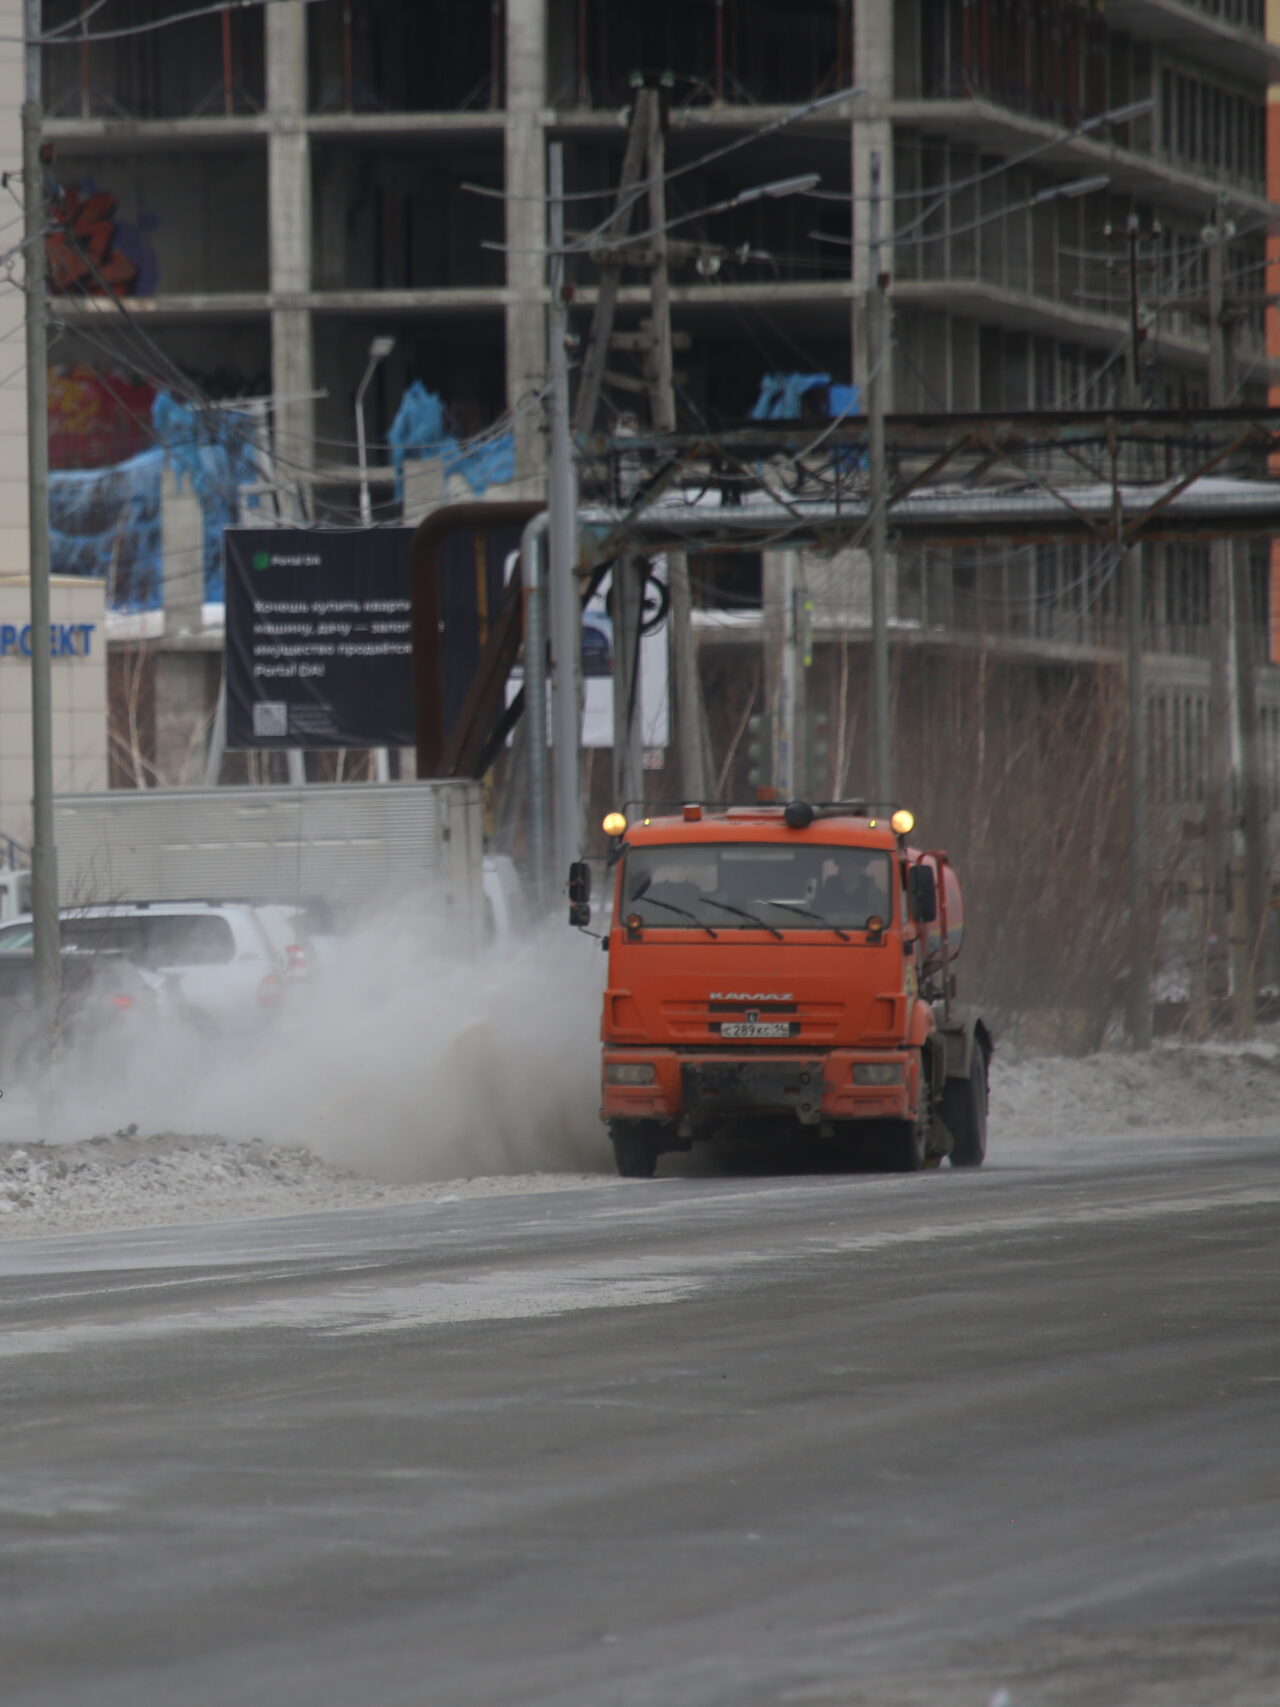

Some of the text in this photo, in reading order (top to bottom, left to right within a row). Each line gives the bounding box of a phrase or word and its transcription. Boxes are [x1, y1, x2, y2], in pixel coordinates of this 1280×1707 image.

[253, 601, 309, 613] Хочешь
[311, 601, 361, 615] купить
[317, 622, 352, 636] дачу
[253, 644, 335, 658] имущество
[253, 664, 297, 676] Portal
[709, 992, 793, 1000] KAMAZ
